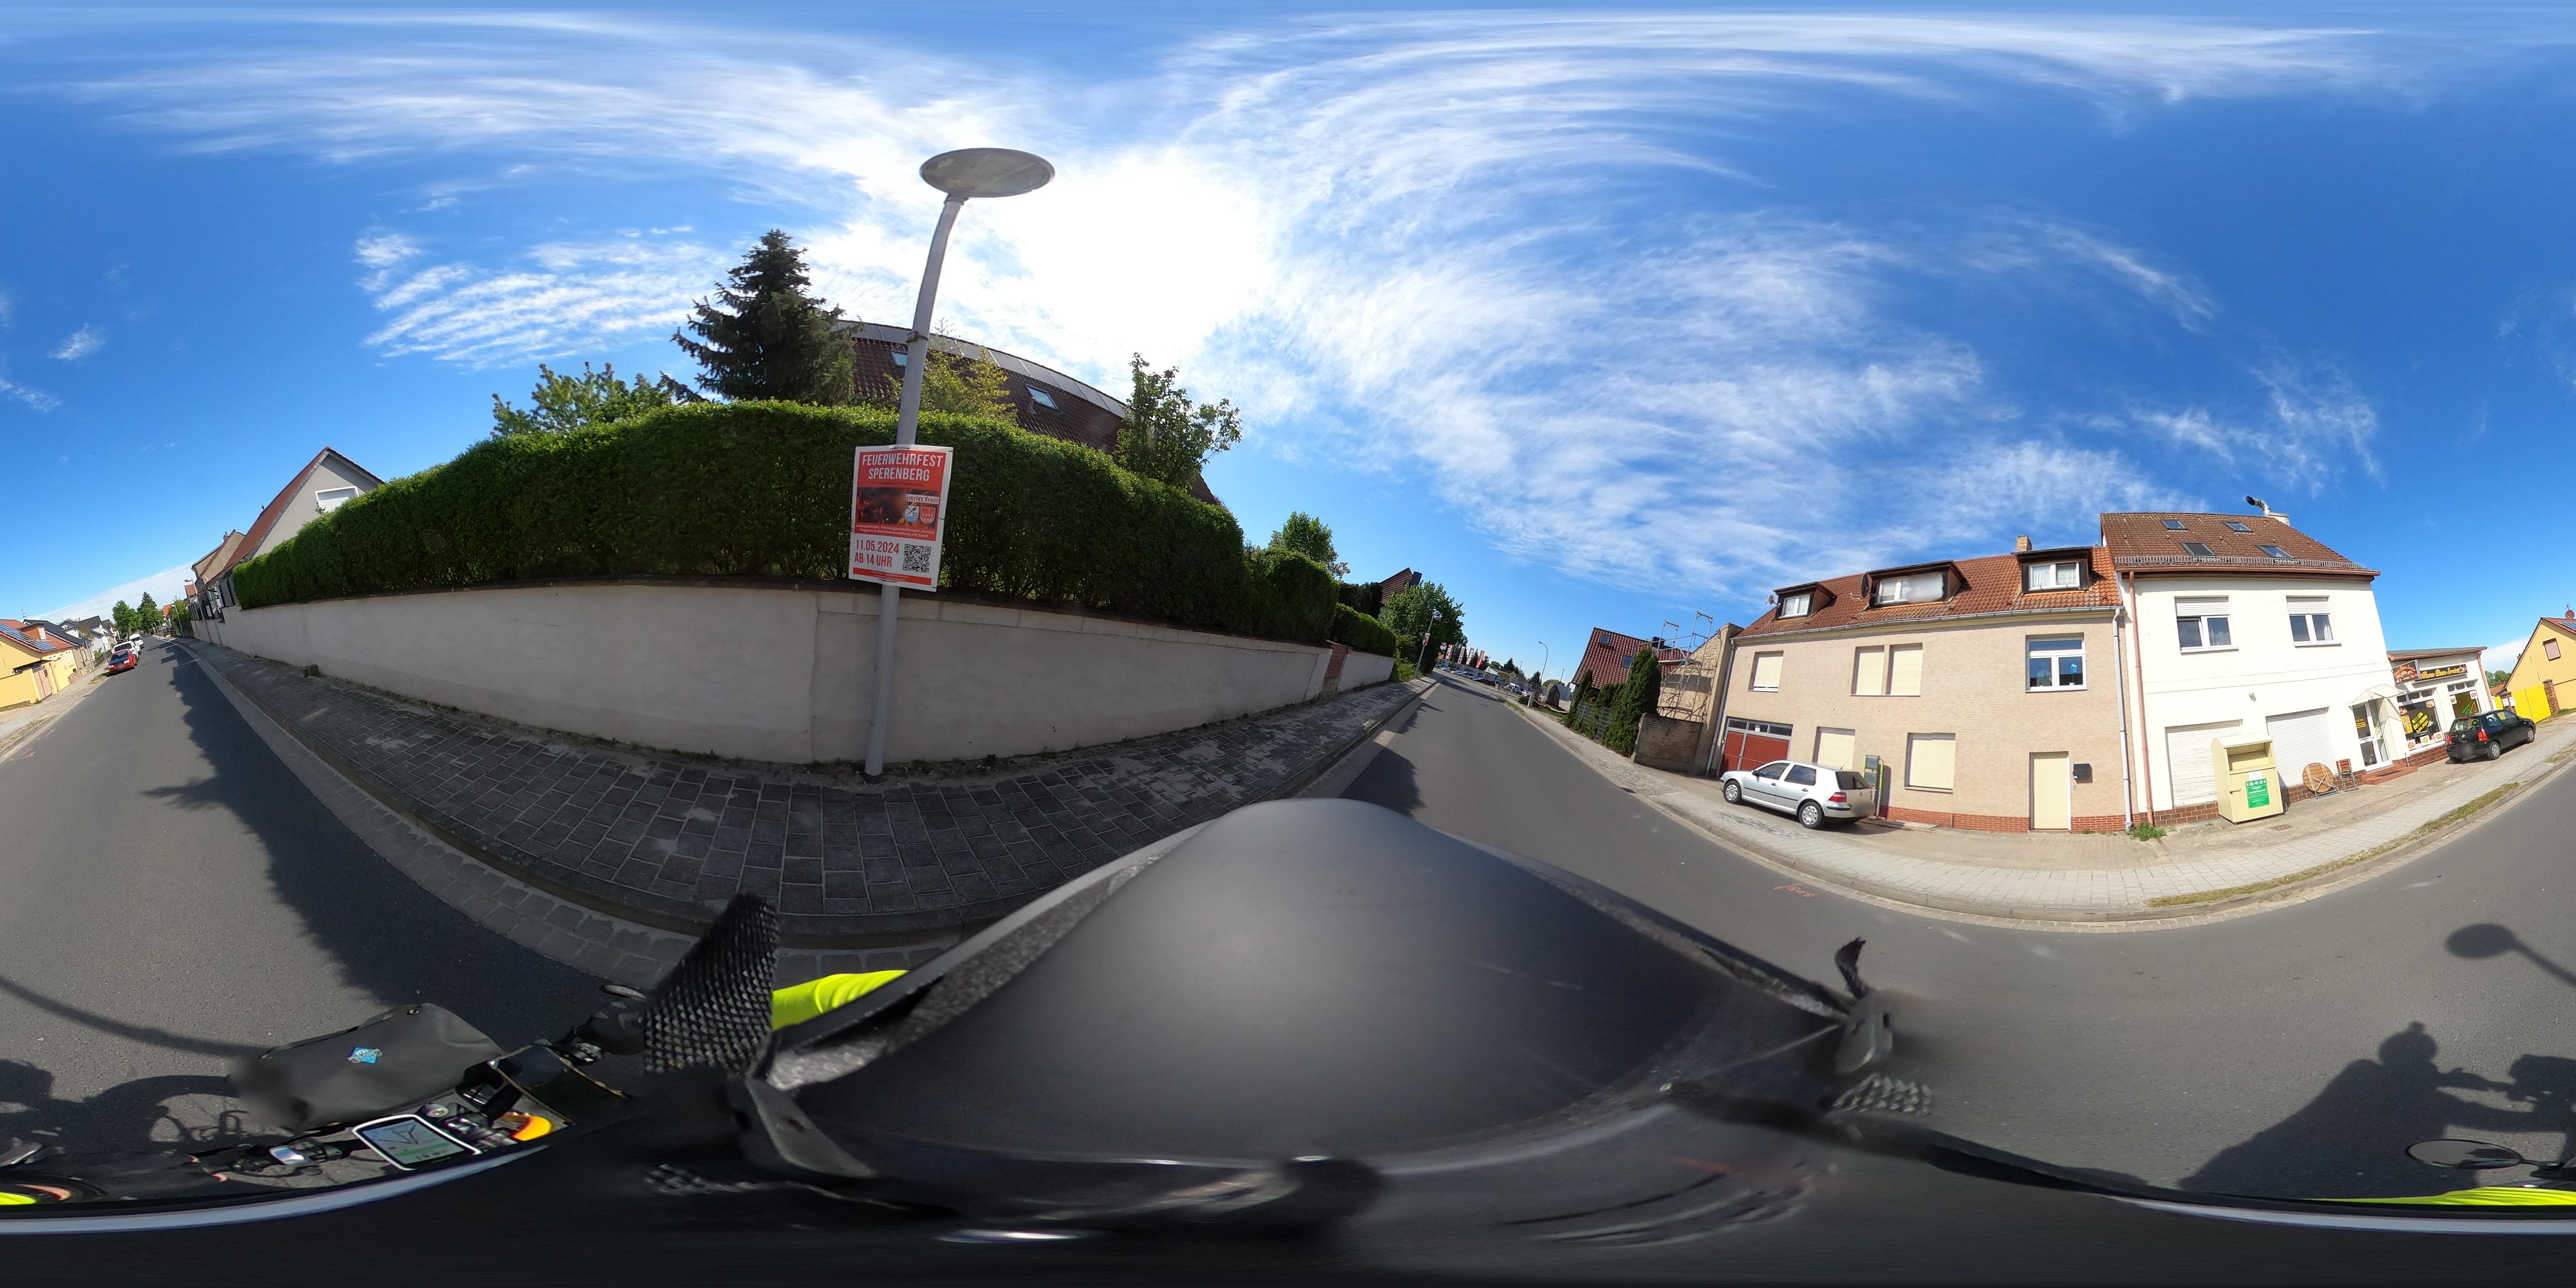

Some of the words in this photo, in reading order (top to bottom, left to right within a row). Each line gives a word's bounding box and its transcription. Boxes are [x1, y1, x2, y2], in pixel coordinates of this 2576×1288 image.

[862, 453, 943, 467] FEUERWEHRFEST
[869, 467, 930, 481] SPERENBERG
[856, 539, 899, 554] 11.05.2024
[855, 552, 864, 563] AB
[866, 554, 874, 565] 14
[877, 555, 892, 567] UHR
